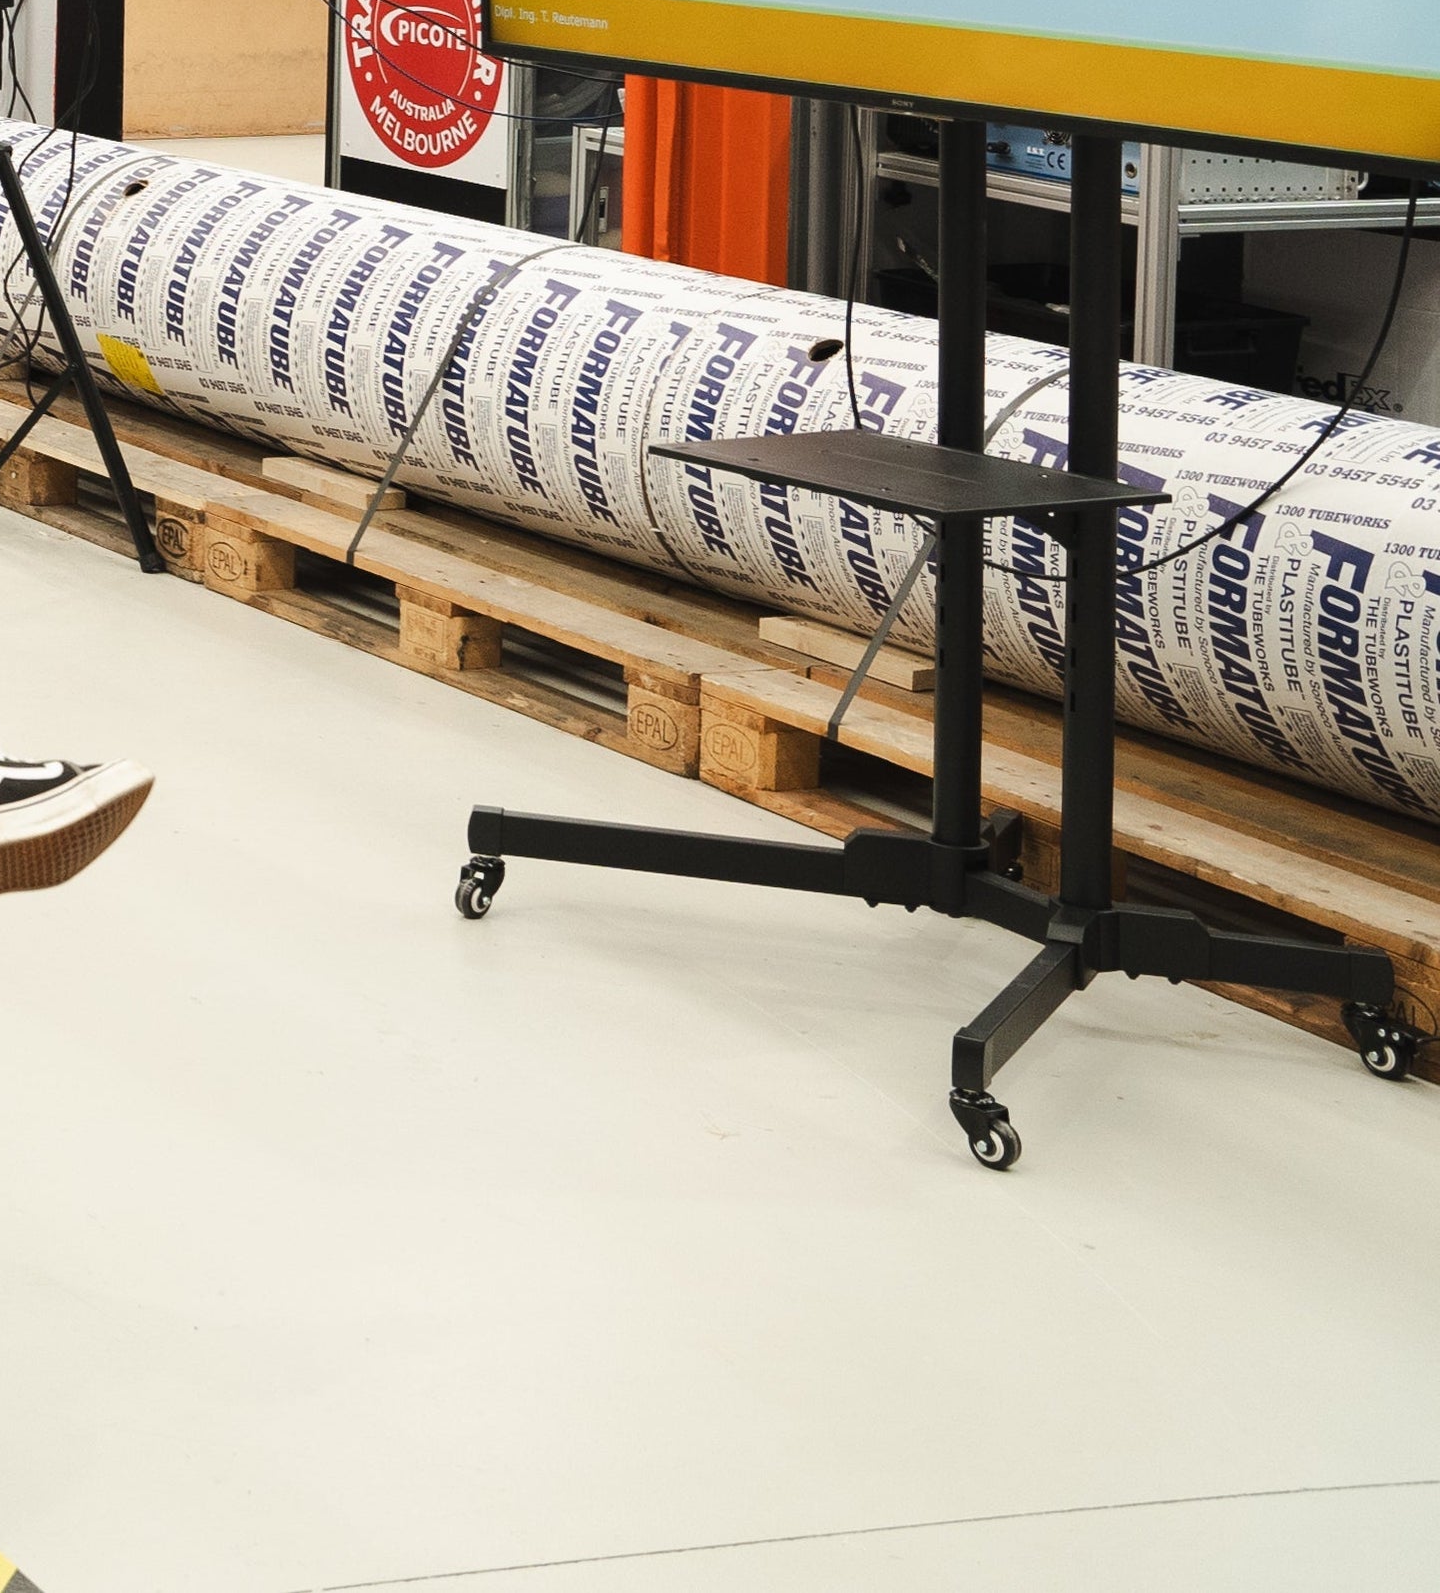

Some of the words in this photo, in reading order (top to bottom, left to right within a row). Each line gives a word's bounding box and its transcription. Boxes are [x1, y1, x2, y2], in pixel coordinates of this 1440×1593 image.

[397, 19, 467, 52] PICOTE
[519, 8, 538, 24] Ing.
[552, 11, 608, 30] Reutemann
[387, 88, 456, 121] AUSTRALIA
[370, 95, 478, 156] MELBOURNE
[166, 180, 267, 351] FORMATUBE
[216, 194, 313, 370] FORMATUBE
[325, 224, 412, 420] FORMATUBE
[506, 278, 582, 500] FORMATUBE
[1300, 372, 1391, 411] edEx
[571, 299, 645, 529] FORMATUBE
[1304, 463, 1325, 476] 03
[1328, 465, 1370, 484] 9457
[1376, 473, 1424, 490] 5545
[162, 521, 186, 552] EPAL
[1277, 505, 1304, 518] 1300
[1308, 509, 1391, 530] TUBEWORKS
[211, 549, 237, 576] EPAL
[1278, 558, 1304, 696] PLASTITUBE
[1303, 562, 1322, 656] Manufactured
[1365, 596, 1381, 628] THE
[1306, 660, 1316, 675] by
[1311, 530, 1429, 812] FORMATUBE
[1364, 632, 1393, 738] TUBEWORKS
[1394, 600, 1424, 740] PLASTITUBE
[636, 710, 671, 745] EPAL
[712, 730, 749, 767] EPAL
